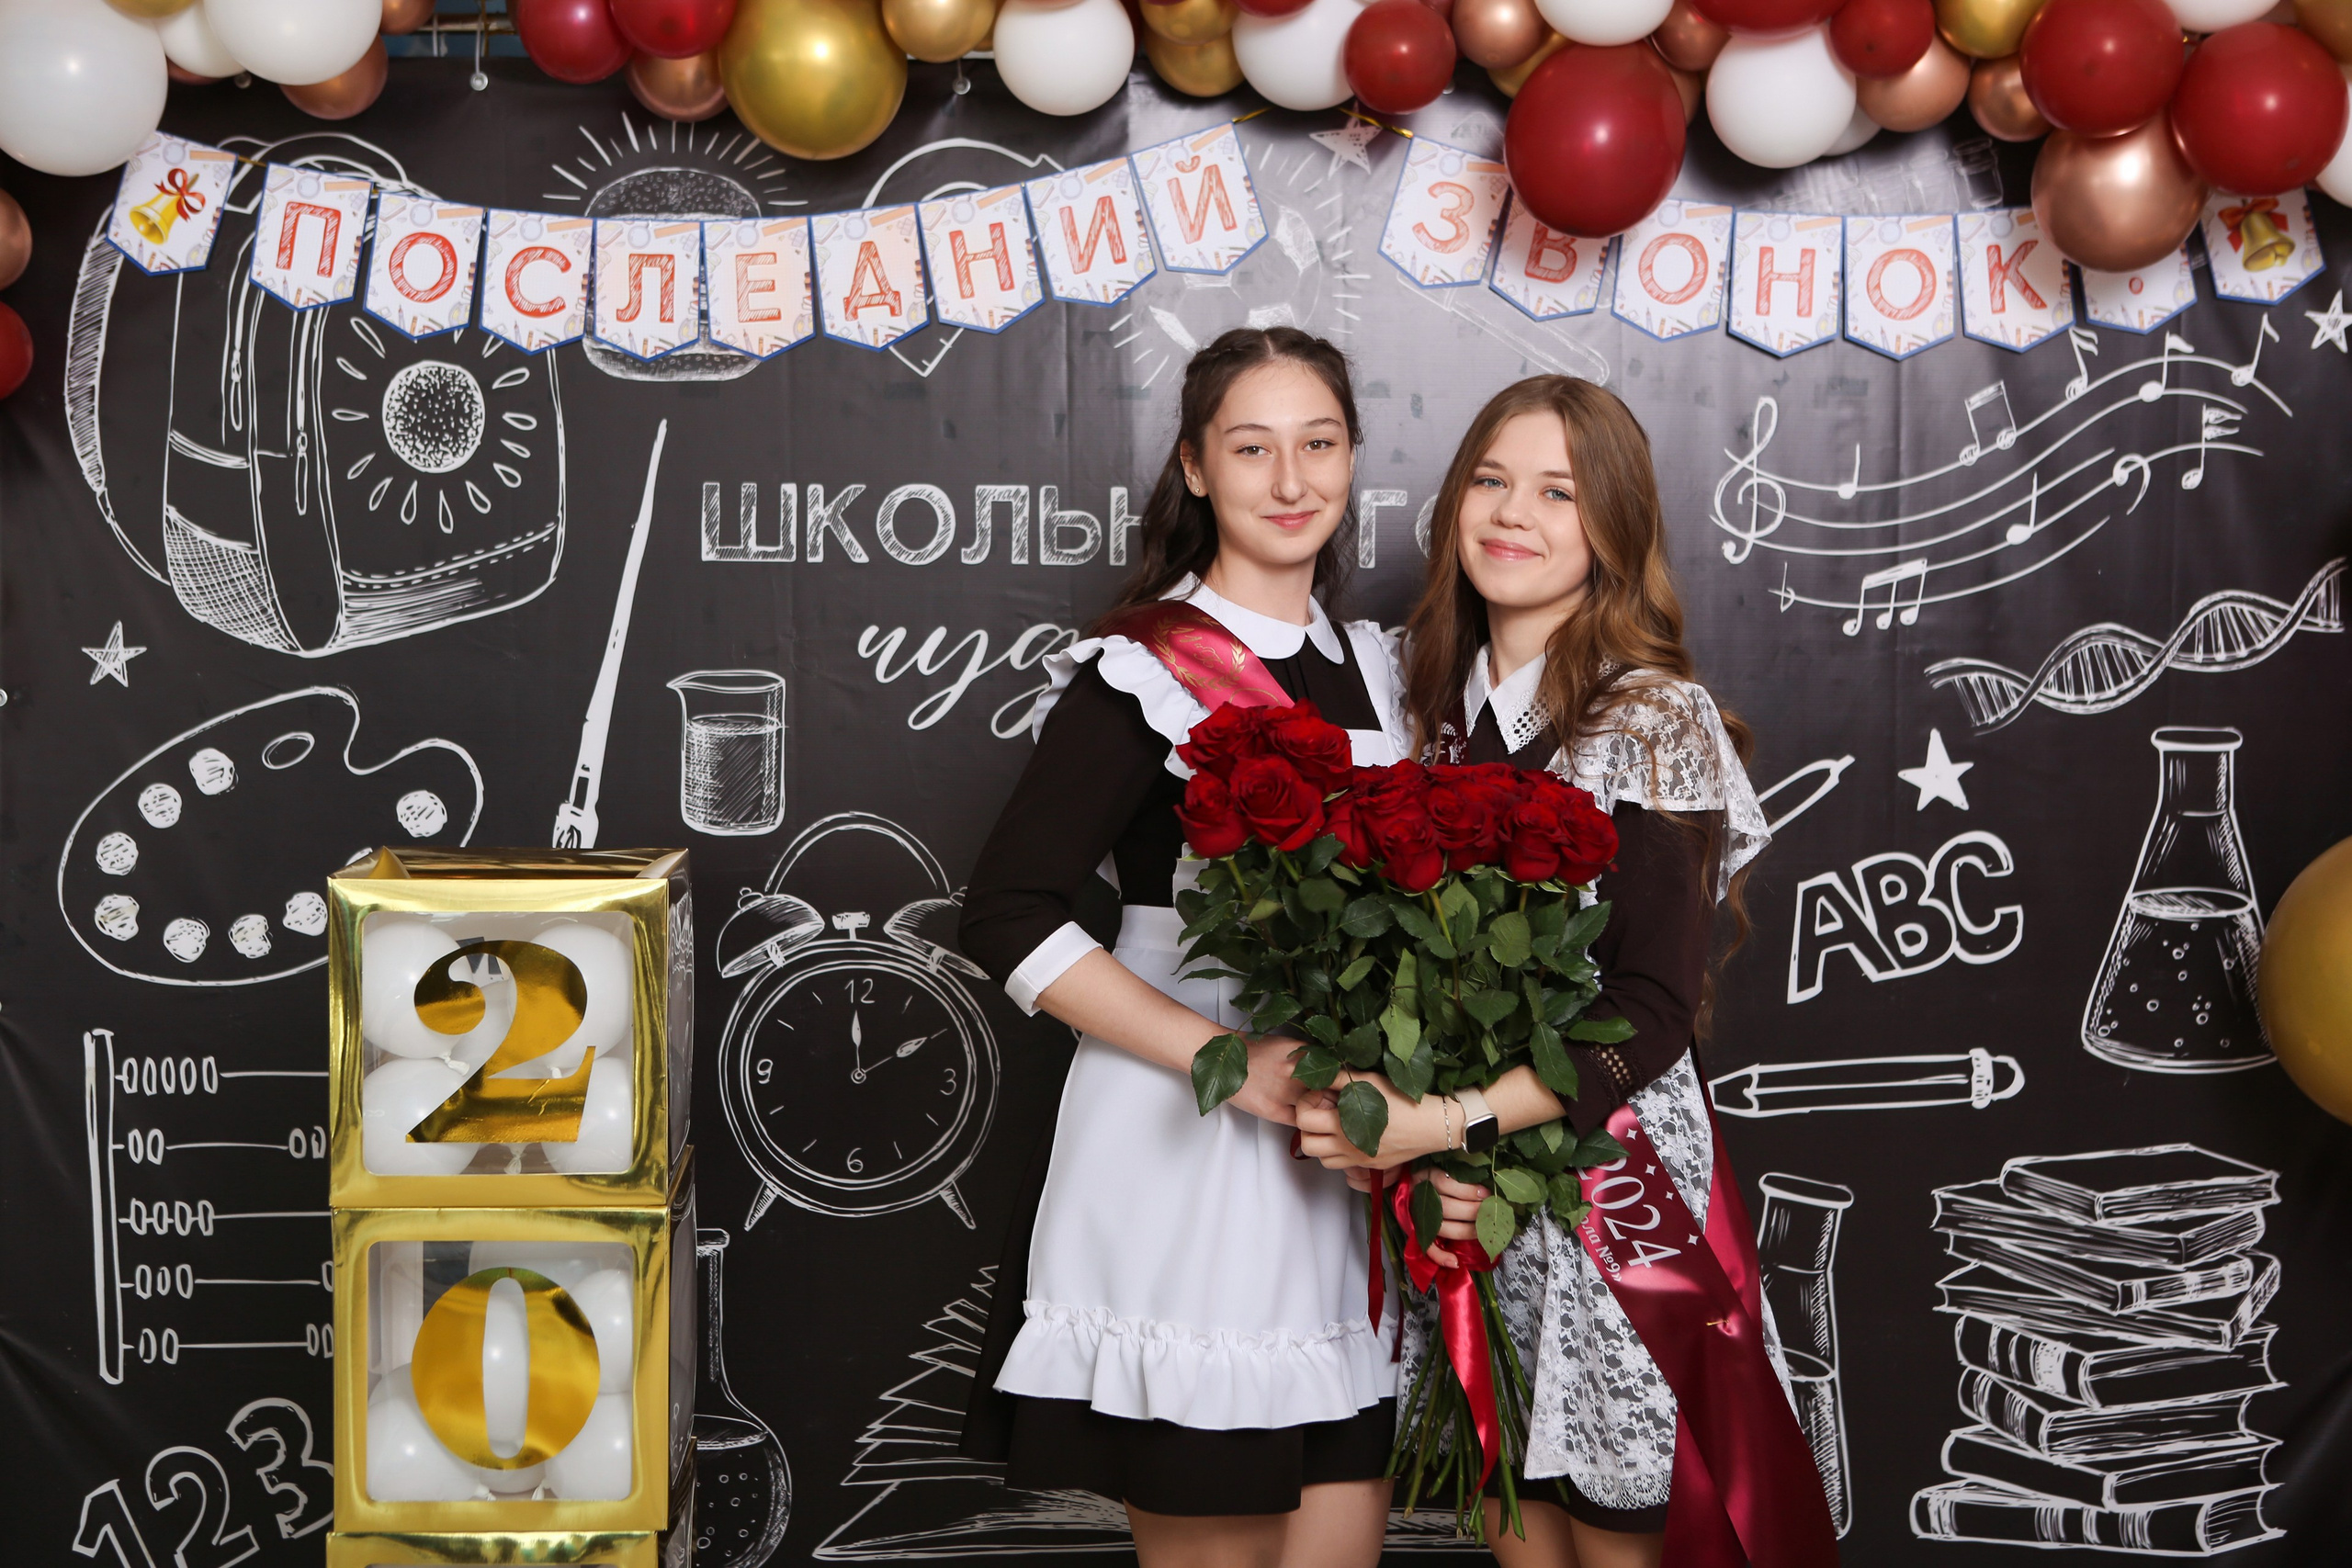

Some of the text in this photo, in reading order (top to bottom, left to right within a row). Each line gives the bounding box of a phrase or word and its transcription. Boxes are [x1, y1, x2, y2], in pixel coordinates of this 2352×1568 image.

[276, 155, 2143, 323] ПОСЛЕДНИЙ ЗВОНОК
[1787, 830, 2023, 1004] ABC
[843, 978, 876, 1005] 12
[755, 1058, 774, 1085] 9
[940, 1067, 958, 1096] 3
[846, 1146, 865, 1173] 6
[1580, 1215, 1601, 1246] ола
[73, 1397, 334, 1568] 123
